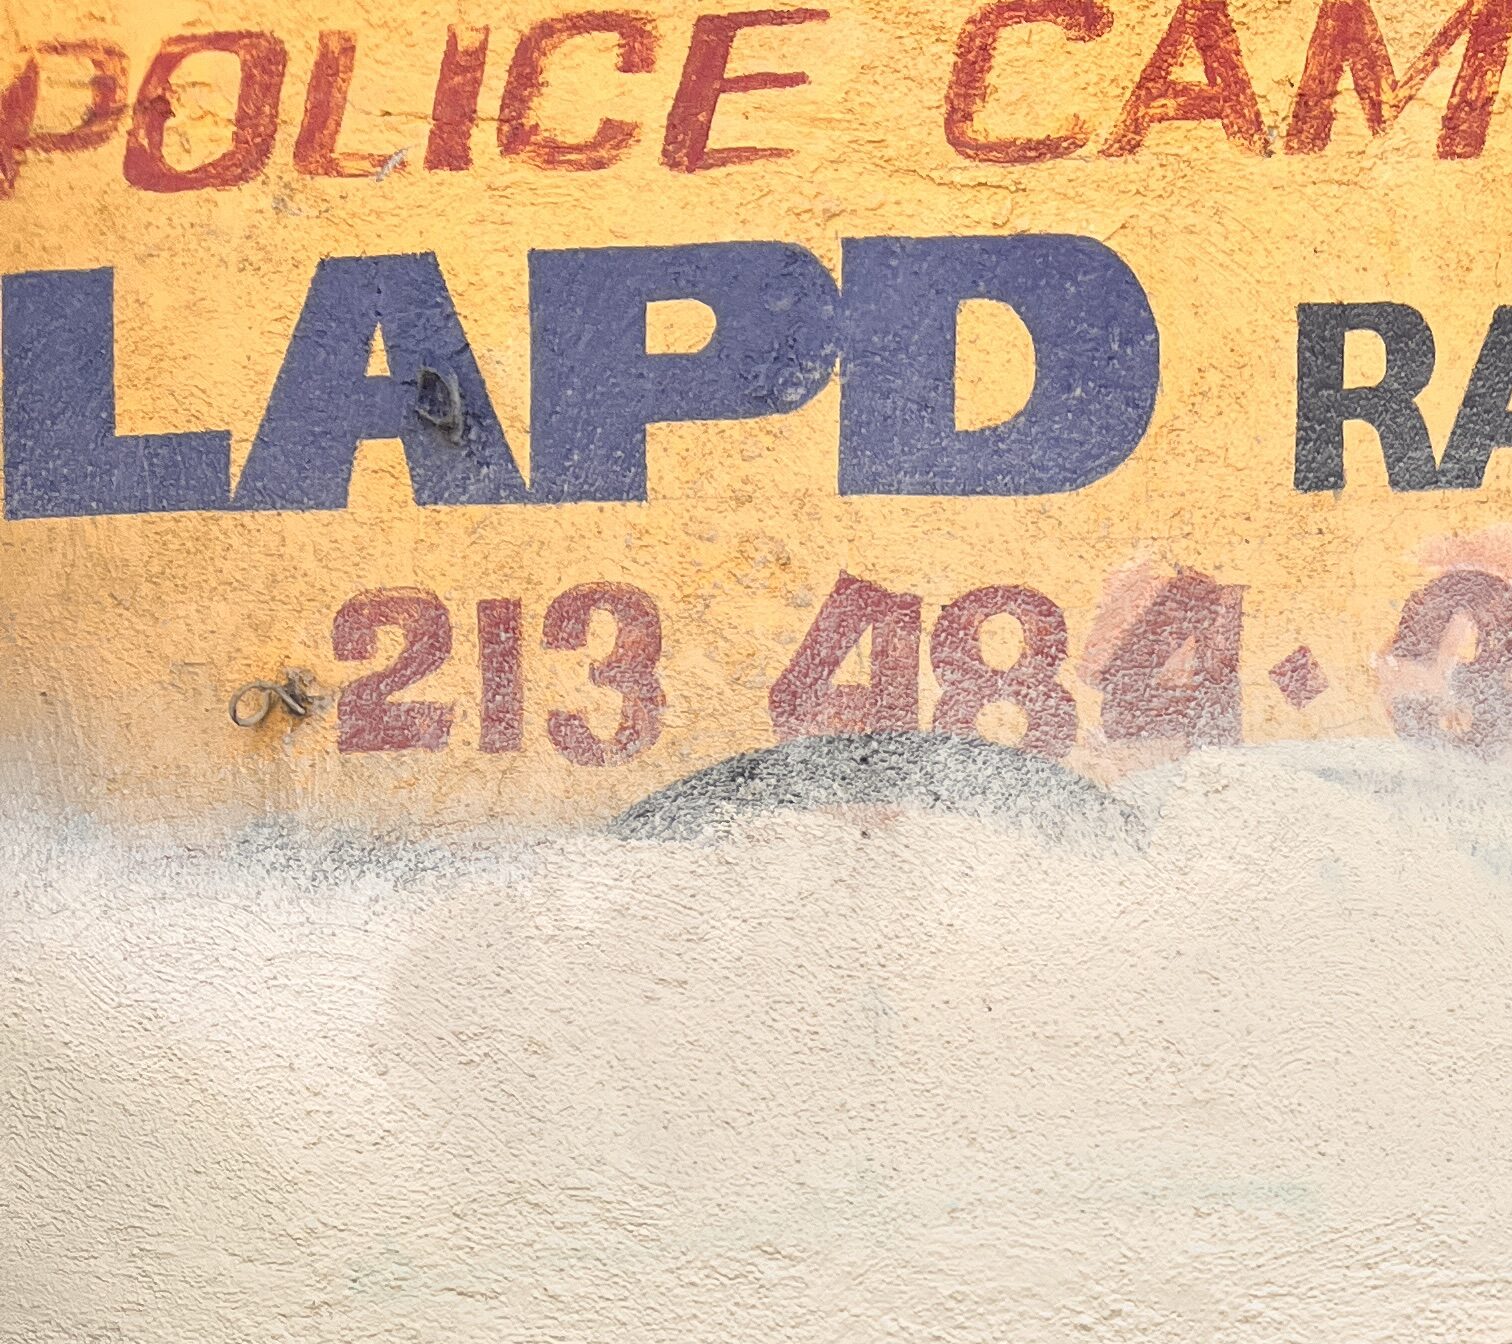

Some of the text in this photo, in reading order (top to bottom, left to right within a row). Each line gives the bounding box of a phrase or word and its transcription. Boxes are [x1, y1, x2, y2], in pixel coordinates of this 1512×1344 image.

[0, 8, 831, 198] POLICE
[0, 233, 1160, 520] LAPD
[331, 581, 666, 767] 213
